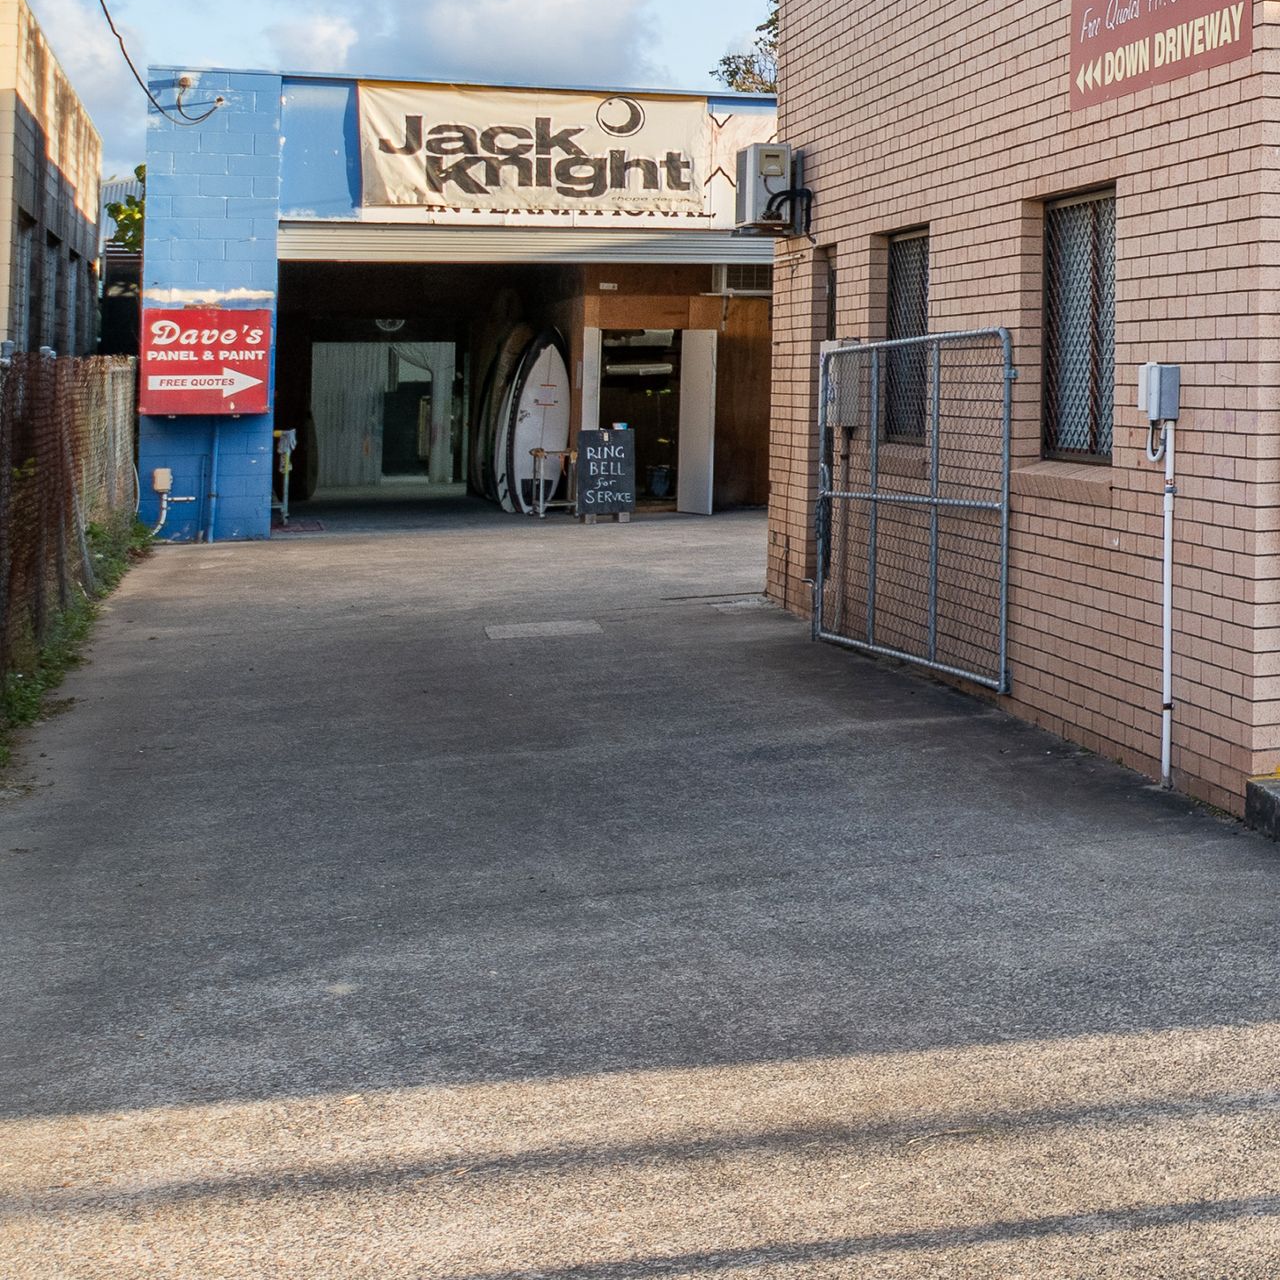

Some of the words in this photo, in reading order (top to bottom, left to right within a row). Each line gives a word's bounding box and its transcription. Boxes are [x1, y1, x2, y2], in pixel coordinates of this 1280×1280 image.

[1104, 37, 1150, 86] DOWN
[1154, 1, 1245, 68] DRIVEWAY
[379, 115, 587, 157] Jack
[425, 150, 691, 198] Knight
[151, 320, 264, 345] Dave's
[147, 350, 198, 361] PANEL
[202, 350, 215, 361] &
[219, 350, 266, 361] PAINT
[159, 378, 188, 387] FREE
[190, 378, 235, 387] QUOTES
[586, 445, 625, 459] RING
[590, 461, 625, 475] BELL
[593, 477, 617, 489] for
[585, 490, 632, 504] SERVICE
